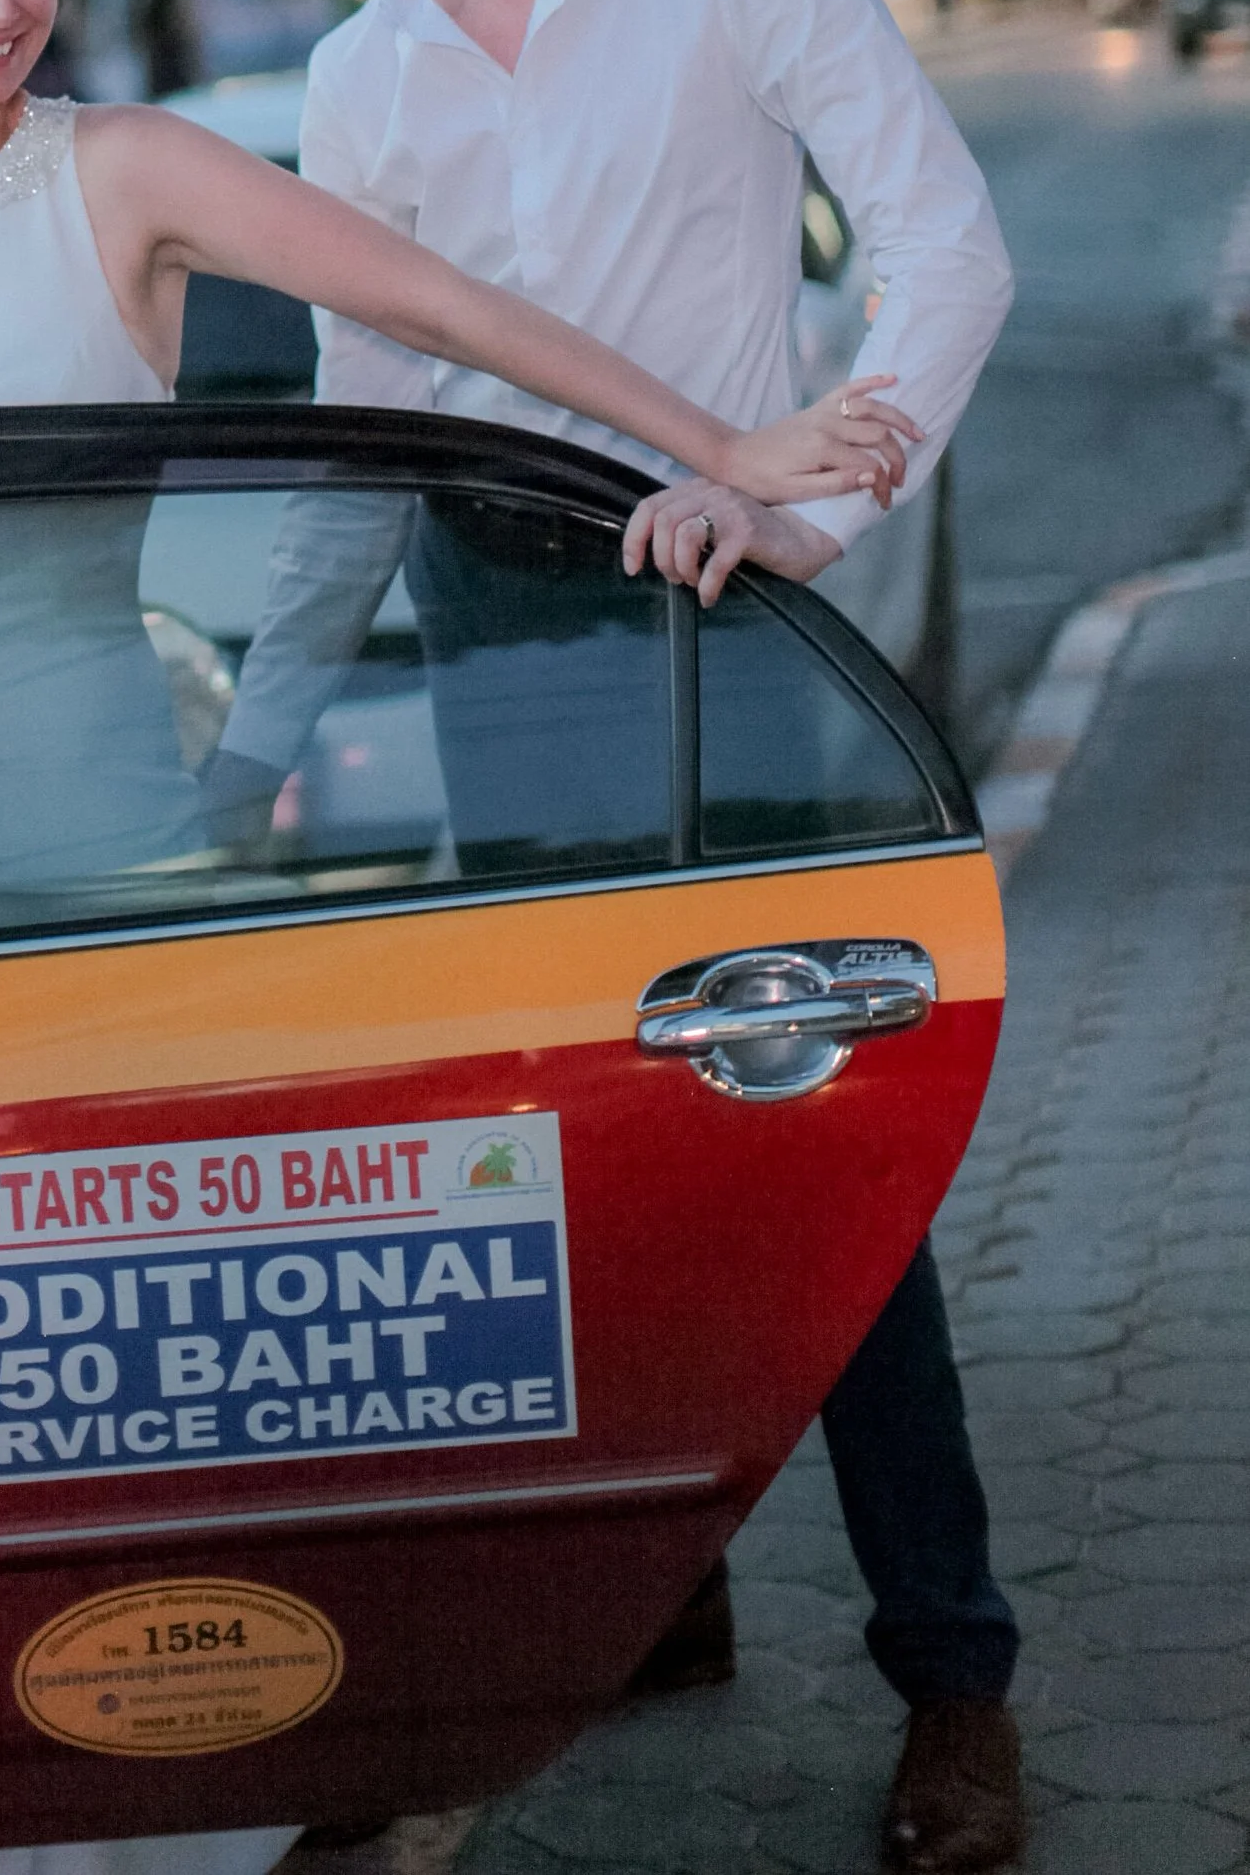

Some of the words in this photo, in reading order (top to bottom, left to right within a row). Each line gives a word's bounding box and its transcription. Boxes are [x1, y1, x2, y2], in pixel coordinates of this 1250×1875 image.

[198, 1154, 262, 1218] 50
[281, 1140, 429, 1211] BAHT
[158, 1315, 446, 1399] BAHT
[245, 1377, 555, 1444] CHARGE
[142, 1618, 249, 1656] 1584
